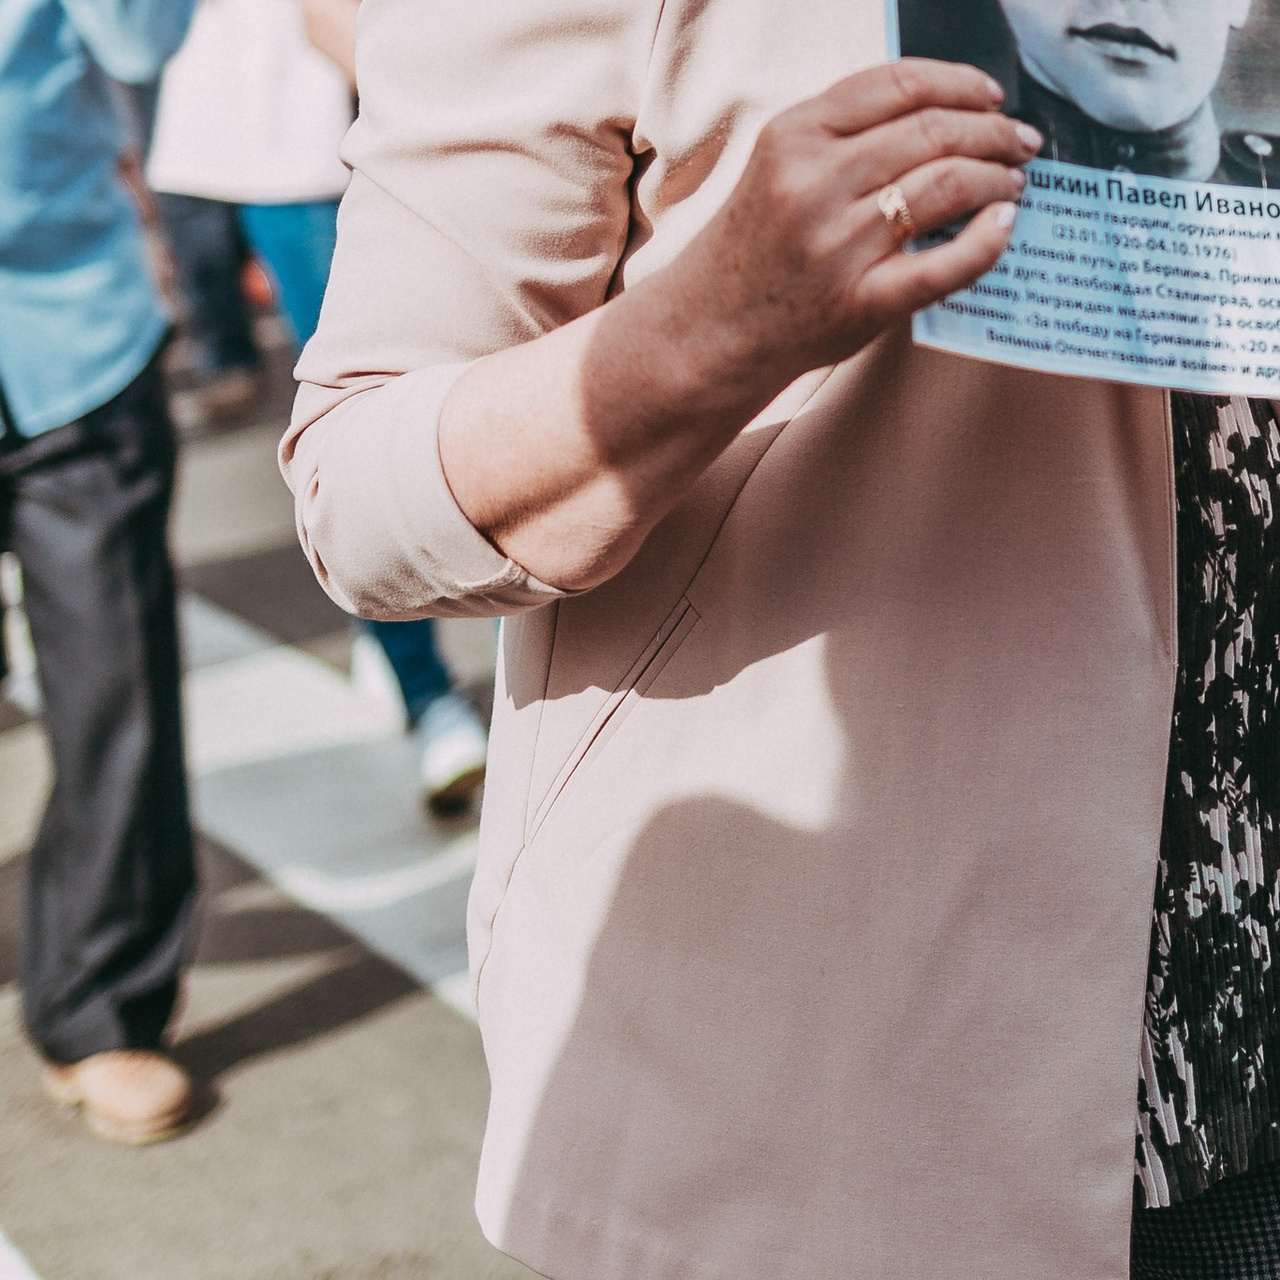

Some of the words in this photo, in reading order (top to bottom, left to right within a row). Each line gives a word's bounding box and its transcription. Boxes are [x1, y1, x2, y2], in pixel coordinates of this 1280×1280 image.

[1028, 170, 1098, 197] шкин
[1107, 178, 1187, 209] Павел
[1037, 200, 1099, 218] сержант
[1104, 213, 1174, 231] гвардии,
[1177, 222, 1271, 240] орудийный
[1020, 240, 1075, 263] боевой
[1079, 253, 1115, 270] путь
[1119, 259, 1139, 273] до
[1143, 259, 1215, 280] Берлина.
[1052, 223, 1237, 260] (23.01.1920-04.10.1976)
[1014, 267, 1051, 283] дуге,
[1054, 273, 1153, 296] освобождал
[1156, 283, 1252, 308] Сталинград,
[1025, 289, 1113, 313] Награжден
[1117, 306, 1198, 325] медалями
[1053, 318, 1109, 339] победу
[987, 327, 1051, 351] Великой
[1055, 340, 1177, 366] Отечественной
[1242, 366, 1250, 374] и
